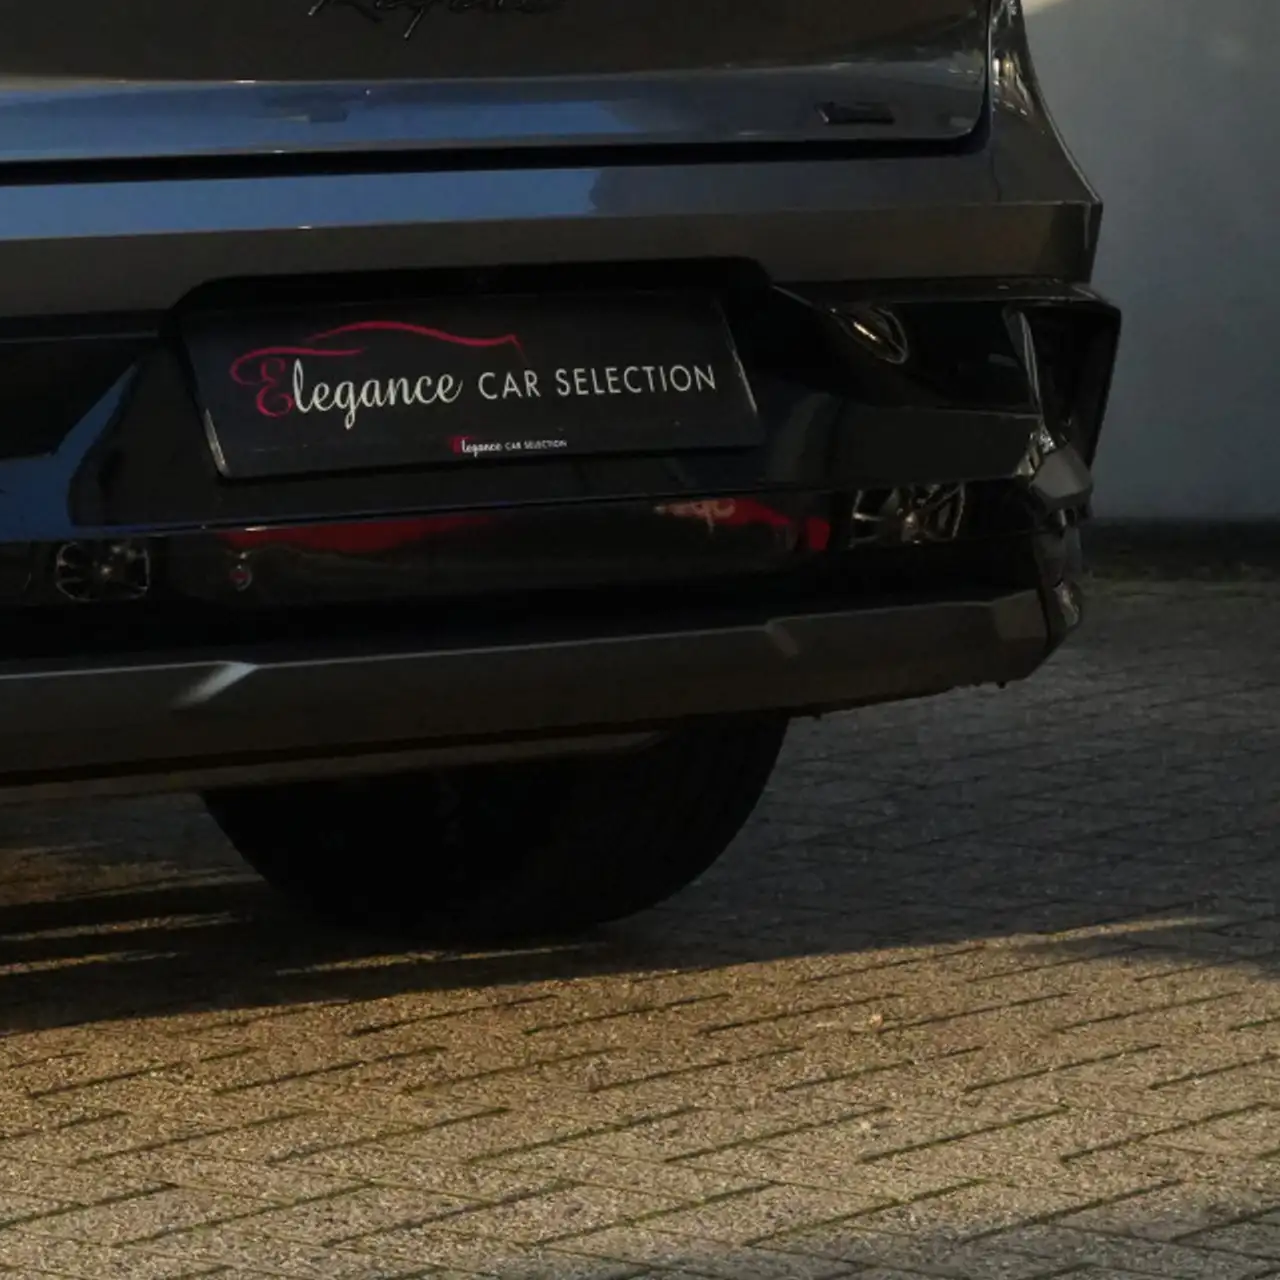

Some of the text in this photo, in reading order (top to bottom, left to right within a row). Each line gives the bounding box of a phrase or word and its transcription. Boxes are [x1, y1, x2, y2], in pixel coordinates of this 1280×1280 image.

[229, 346, 717, 431] Elegance CAR SELECTION
